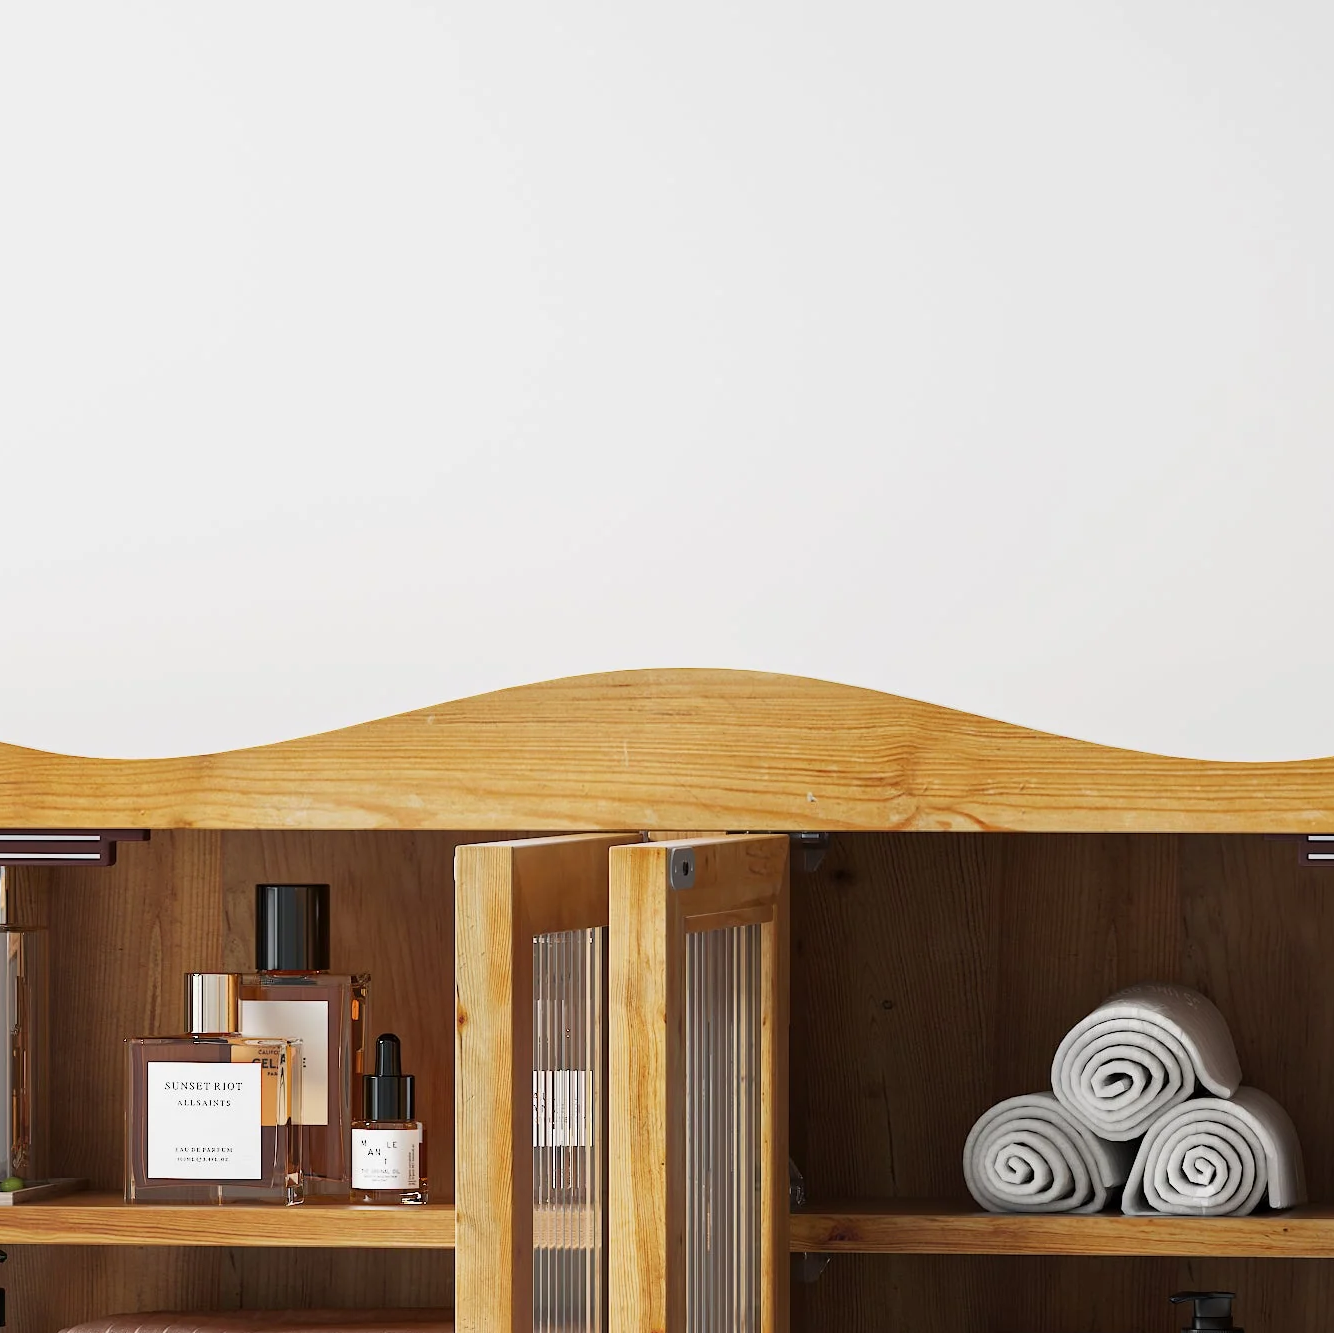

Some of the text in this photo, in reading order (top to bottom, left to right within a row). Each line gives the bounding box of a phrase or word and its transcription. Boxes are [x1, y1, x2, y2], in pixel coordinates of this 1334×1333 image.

[164, 1082, 243, 1091] SUNSET RIOT
[177, 1099, 231, 1107] ALLSAINTS
